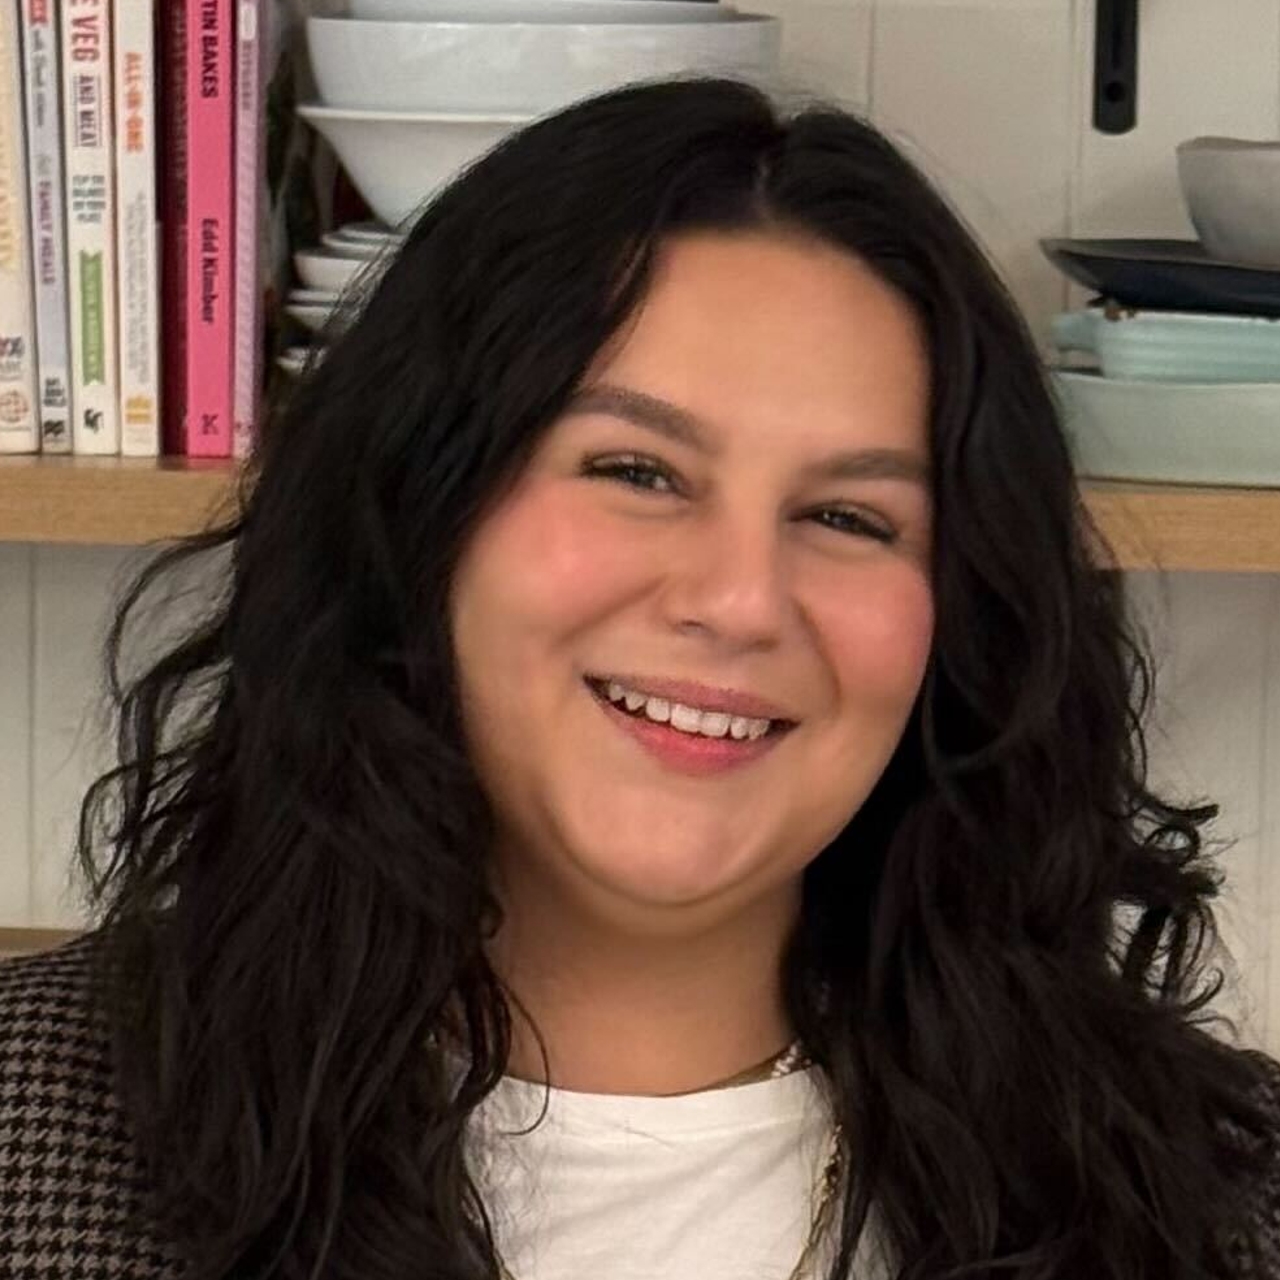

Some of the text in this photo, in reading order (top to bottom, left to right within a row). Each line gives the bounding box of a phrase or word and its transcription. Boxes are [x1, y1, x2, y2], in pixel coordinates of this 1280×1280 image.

[70, 14, 101, 63] VEG
[77, 74, 96, 104] AND
[200, 34, 219, 99] BAKES
[78, 109, 97, 147] MEAT
[37, 179, 53, 231] FAMILY
[200, 216, 219, 324] Edd Kimber
